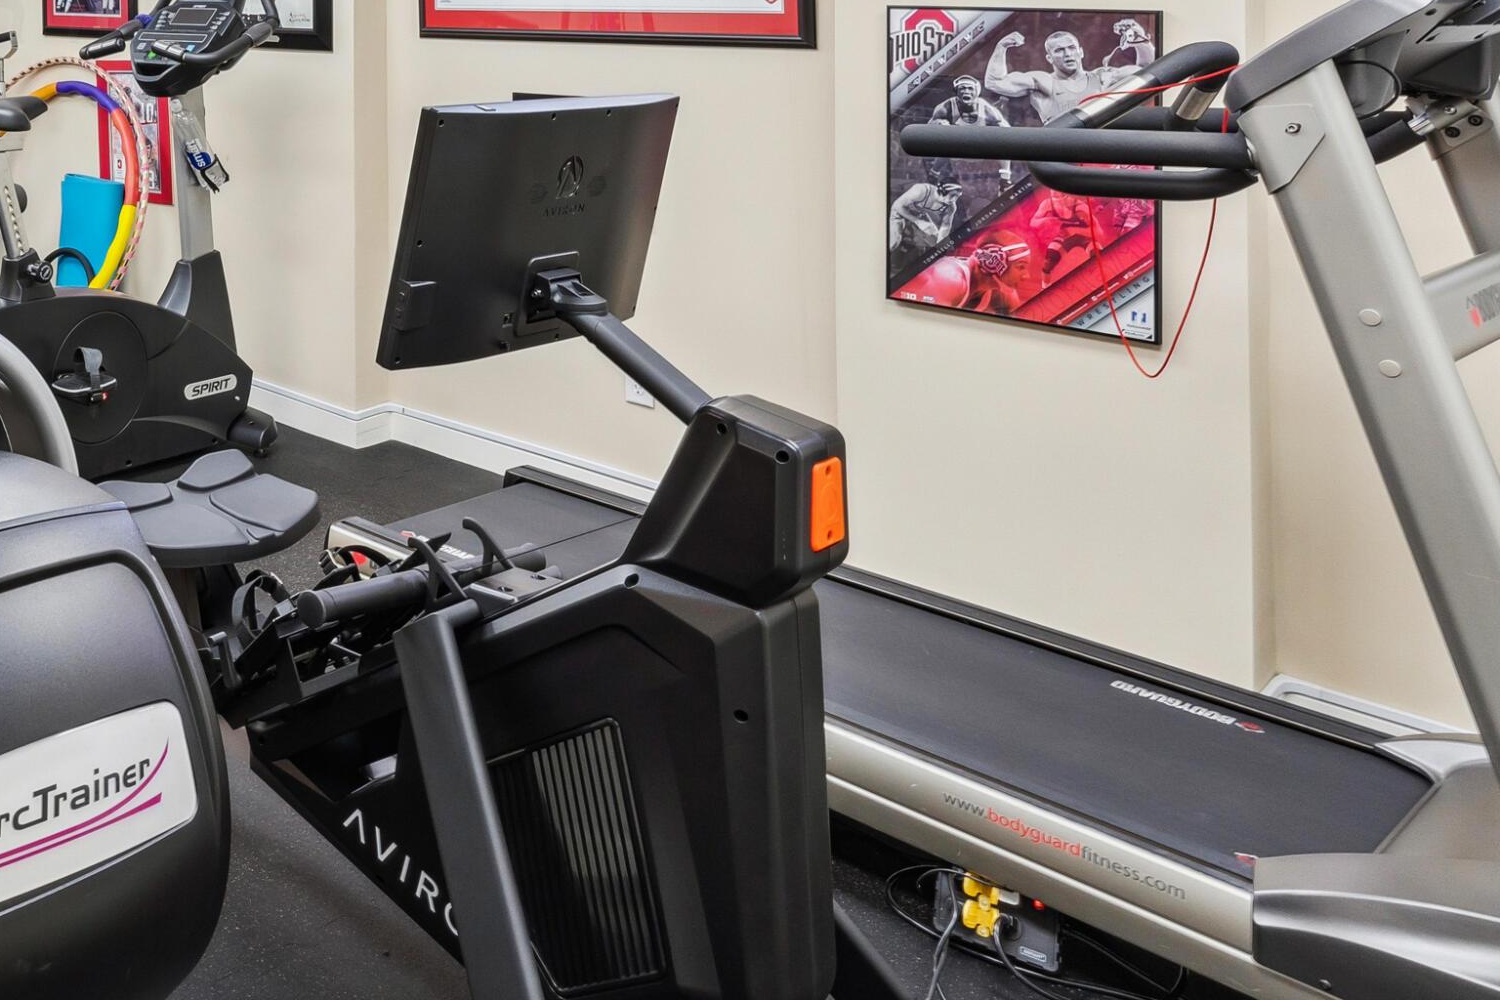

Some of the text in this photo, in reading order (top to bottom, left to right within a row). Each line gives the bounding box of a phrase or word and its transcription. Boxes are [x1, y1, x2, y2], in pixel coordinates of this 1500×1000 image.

[191, 377, 231, 397] SPIRIT
[1110, 679, 1240, 726] BODYGUARD
[942, 791, 1188, 900] www.bodyguardfitness.com
